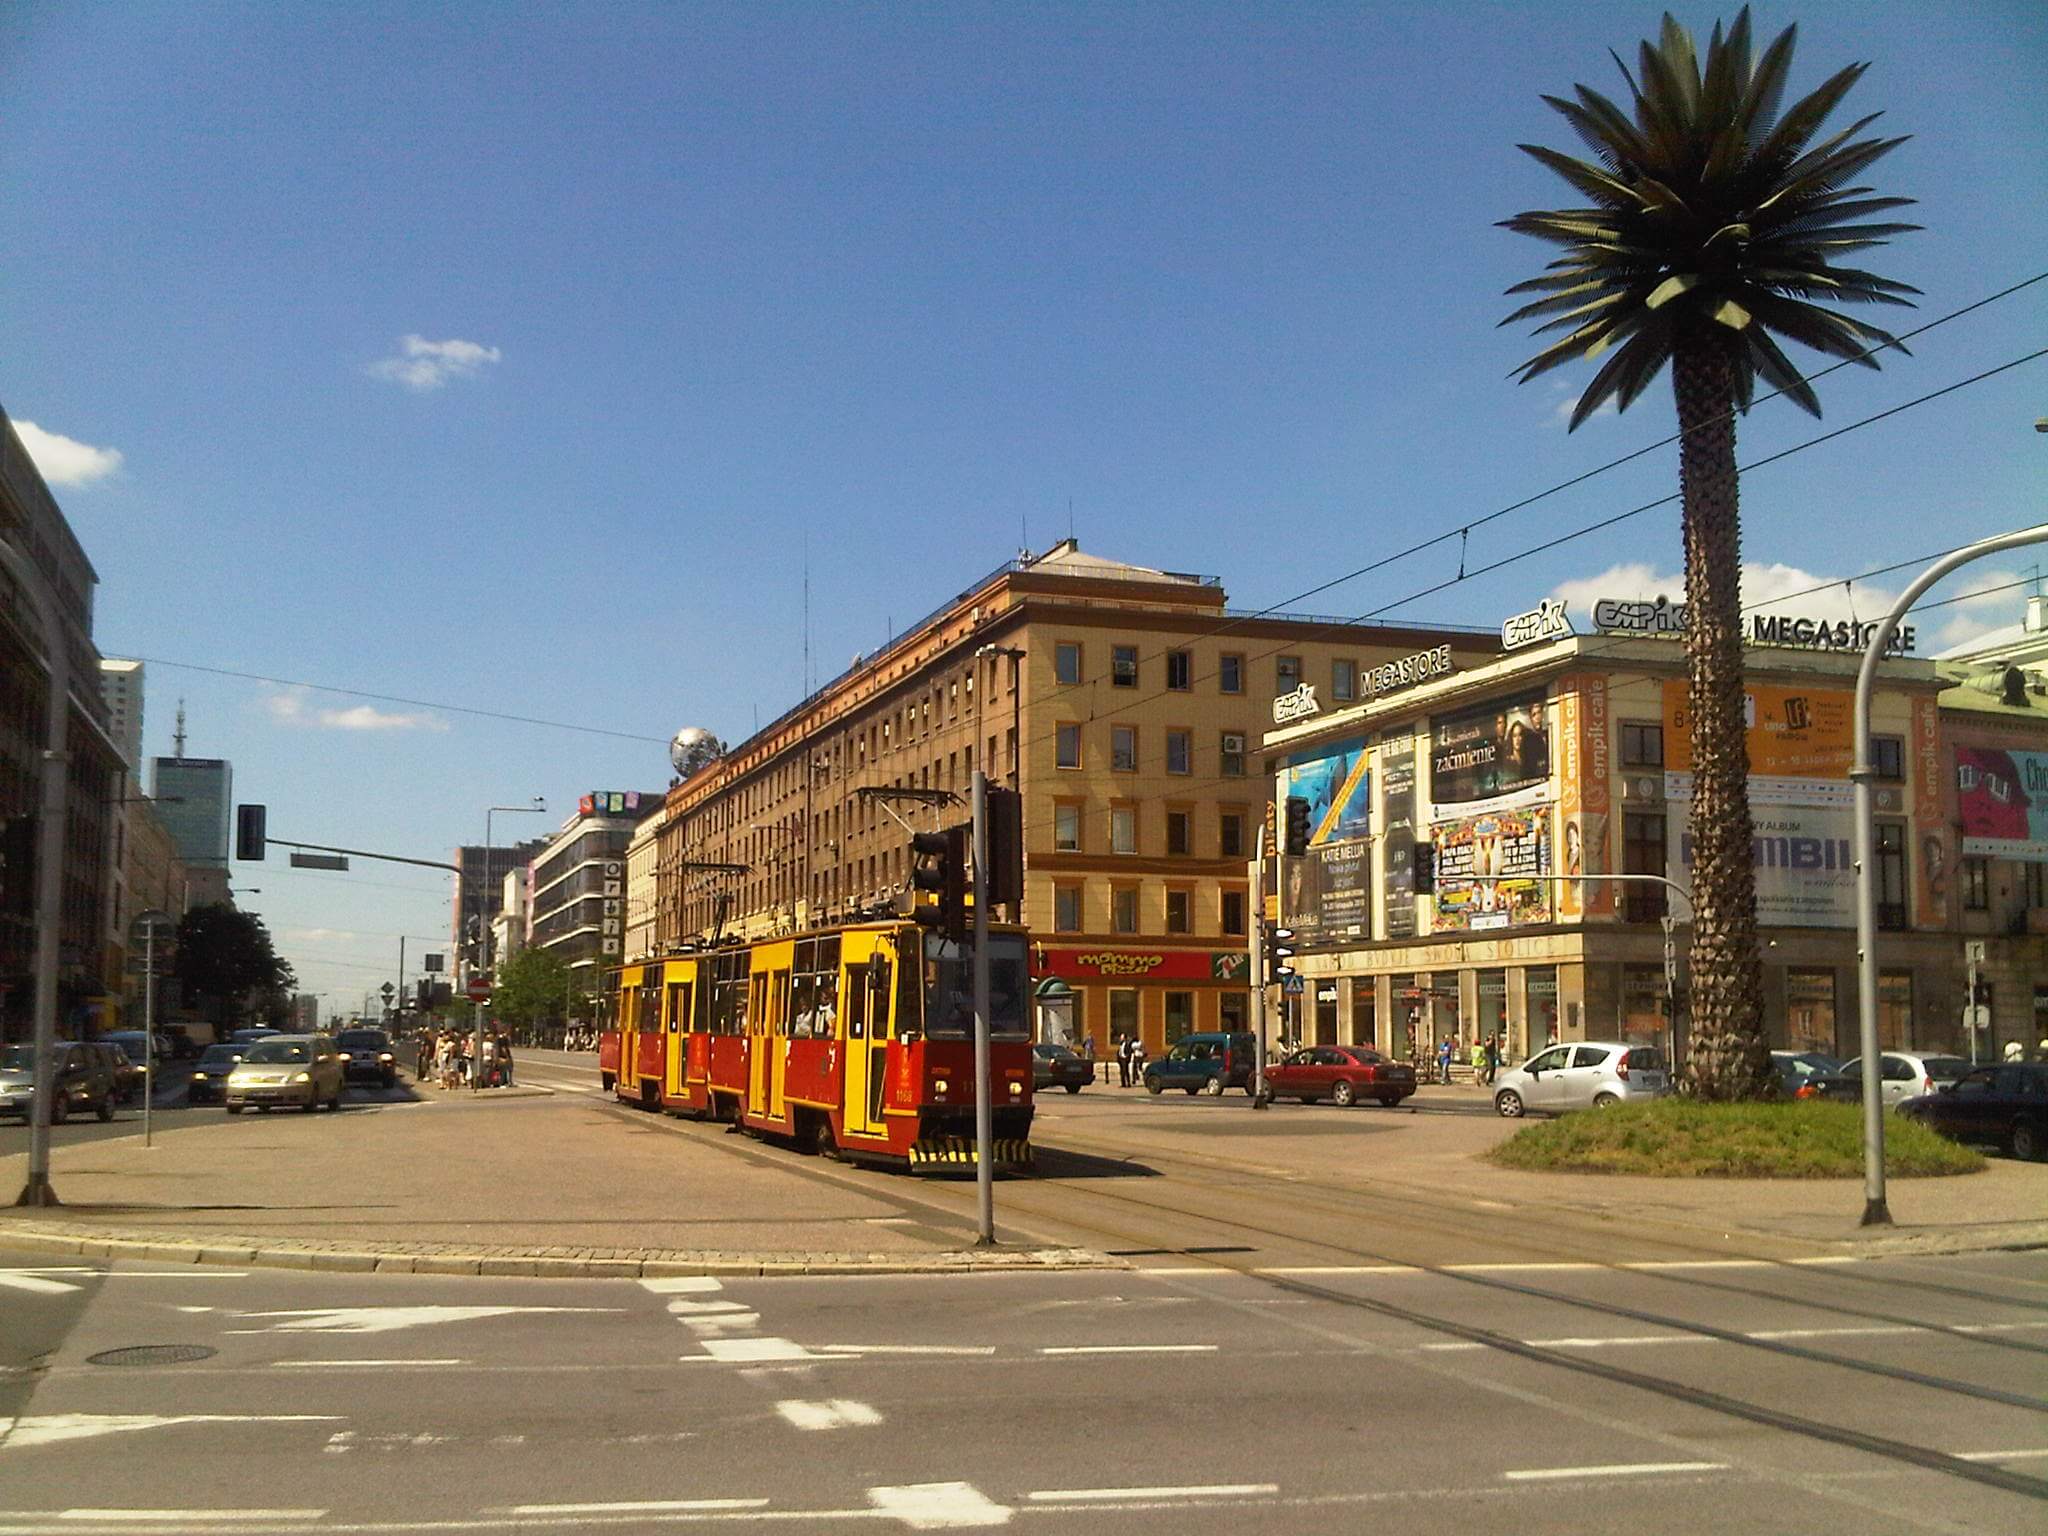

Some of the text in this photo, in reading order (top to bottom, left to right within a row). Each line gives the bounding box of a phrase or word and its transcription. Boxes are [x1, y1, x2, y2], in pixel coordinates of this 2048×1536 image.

[1361, 643, 1451, 696] MEGASTORE
[1563, 719, 1577, 779] empik
[1588, 721, 1607, 779] empik
